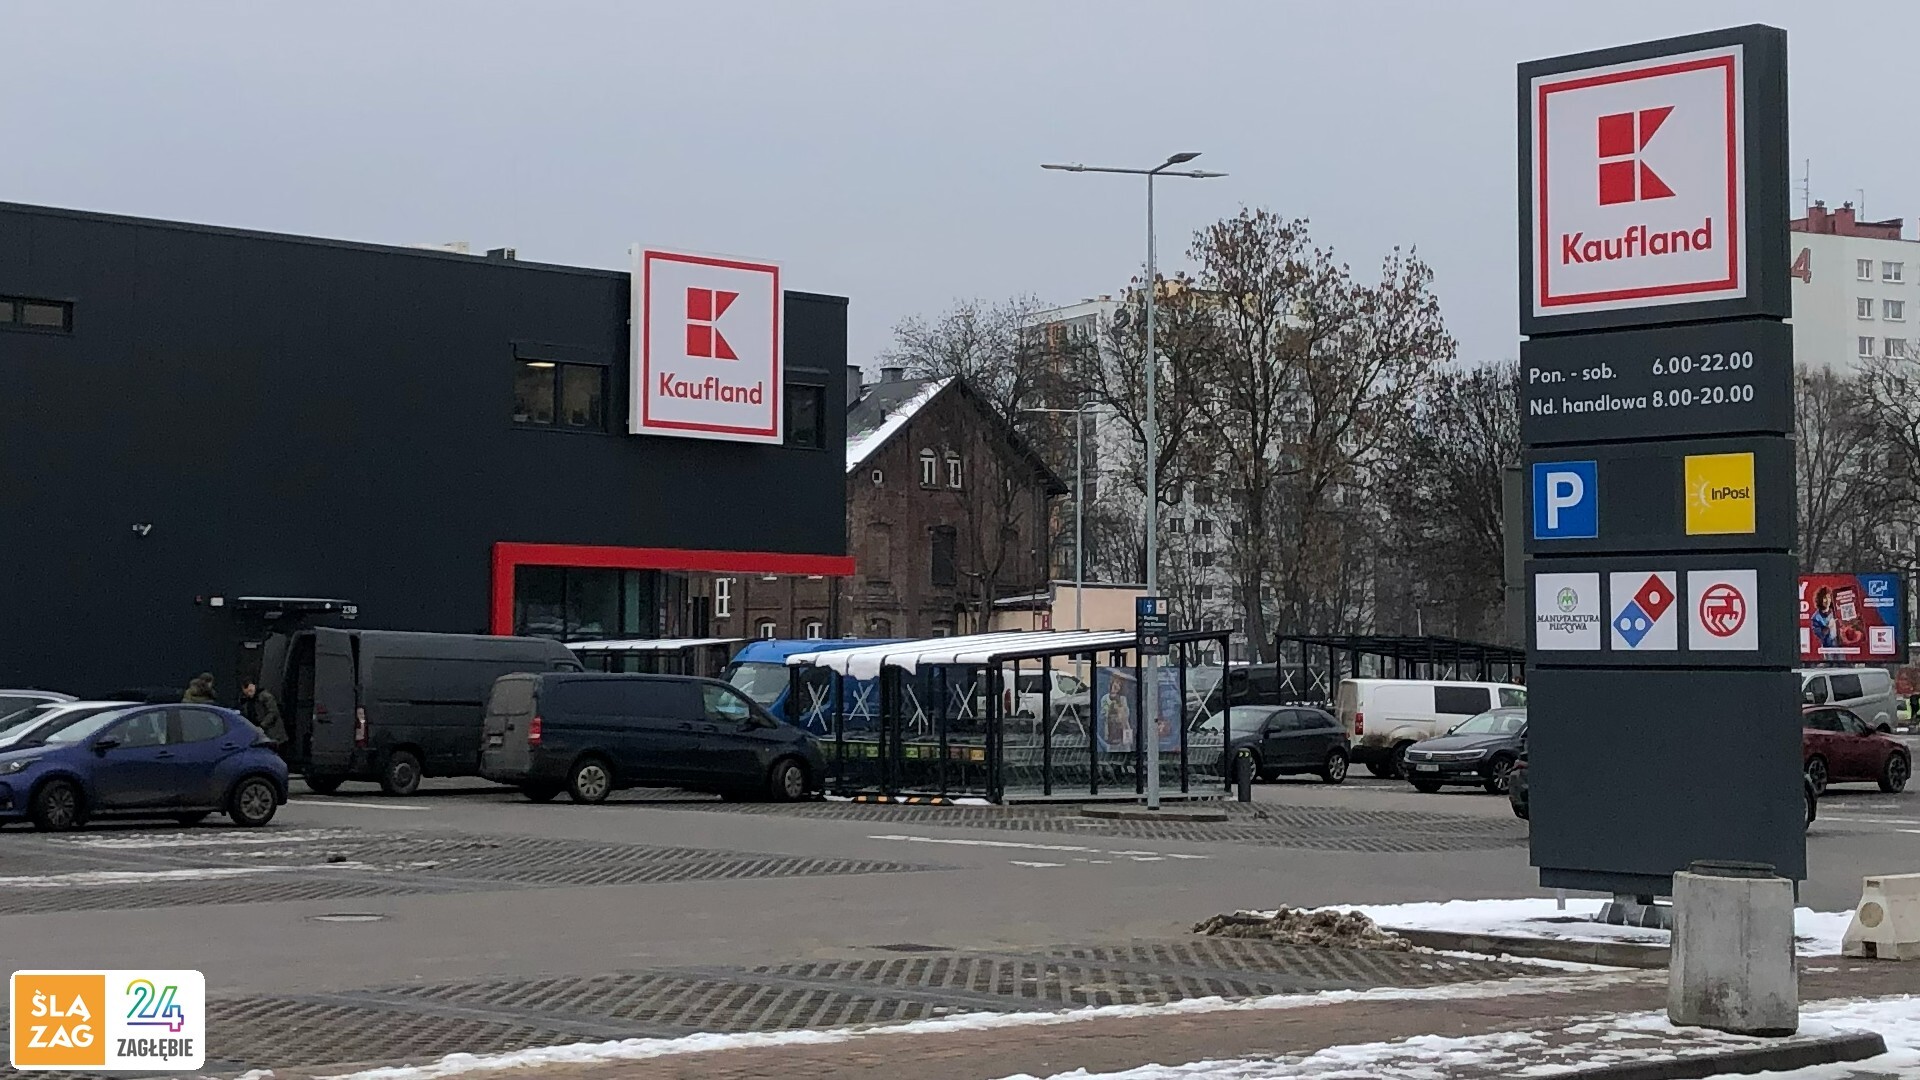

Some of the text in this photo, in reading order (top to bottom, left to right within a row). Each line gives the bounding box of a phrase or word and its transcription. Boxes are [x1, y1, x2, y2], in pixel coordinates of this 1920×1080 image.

[1562, 217, 1712, 265] Kaufland
[1529, 367, 1566, 384] Pon.
[1582, 362, 1617, 381] sob.
[1652, 351, 1754, 376] 6.00-22.00
[660, 372, 762, 404] Kaufland
[1530, 384, 1754, 416] Nd. handlowa 8.00-20.00
[1546, 471, 1584, 529] P
[1711, 485, 1750, 501] InPost
